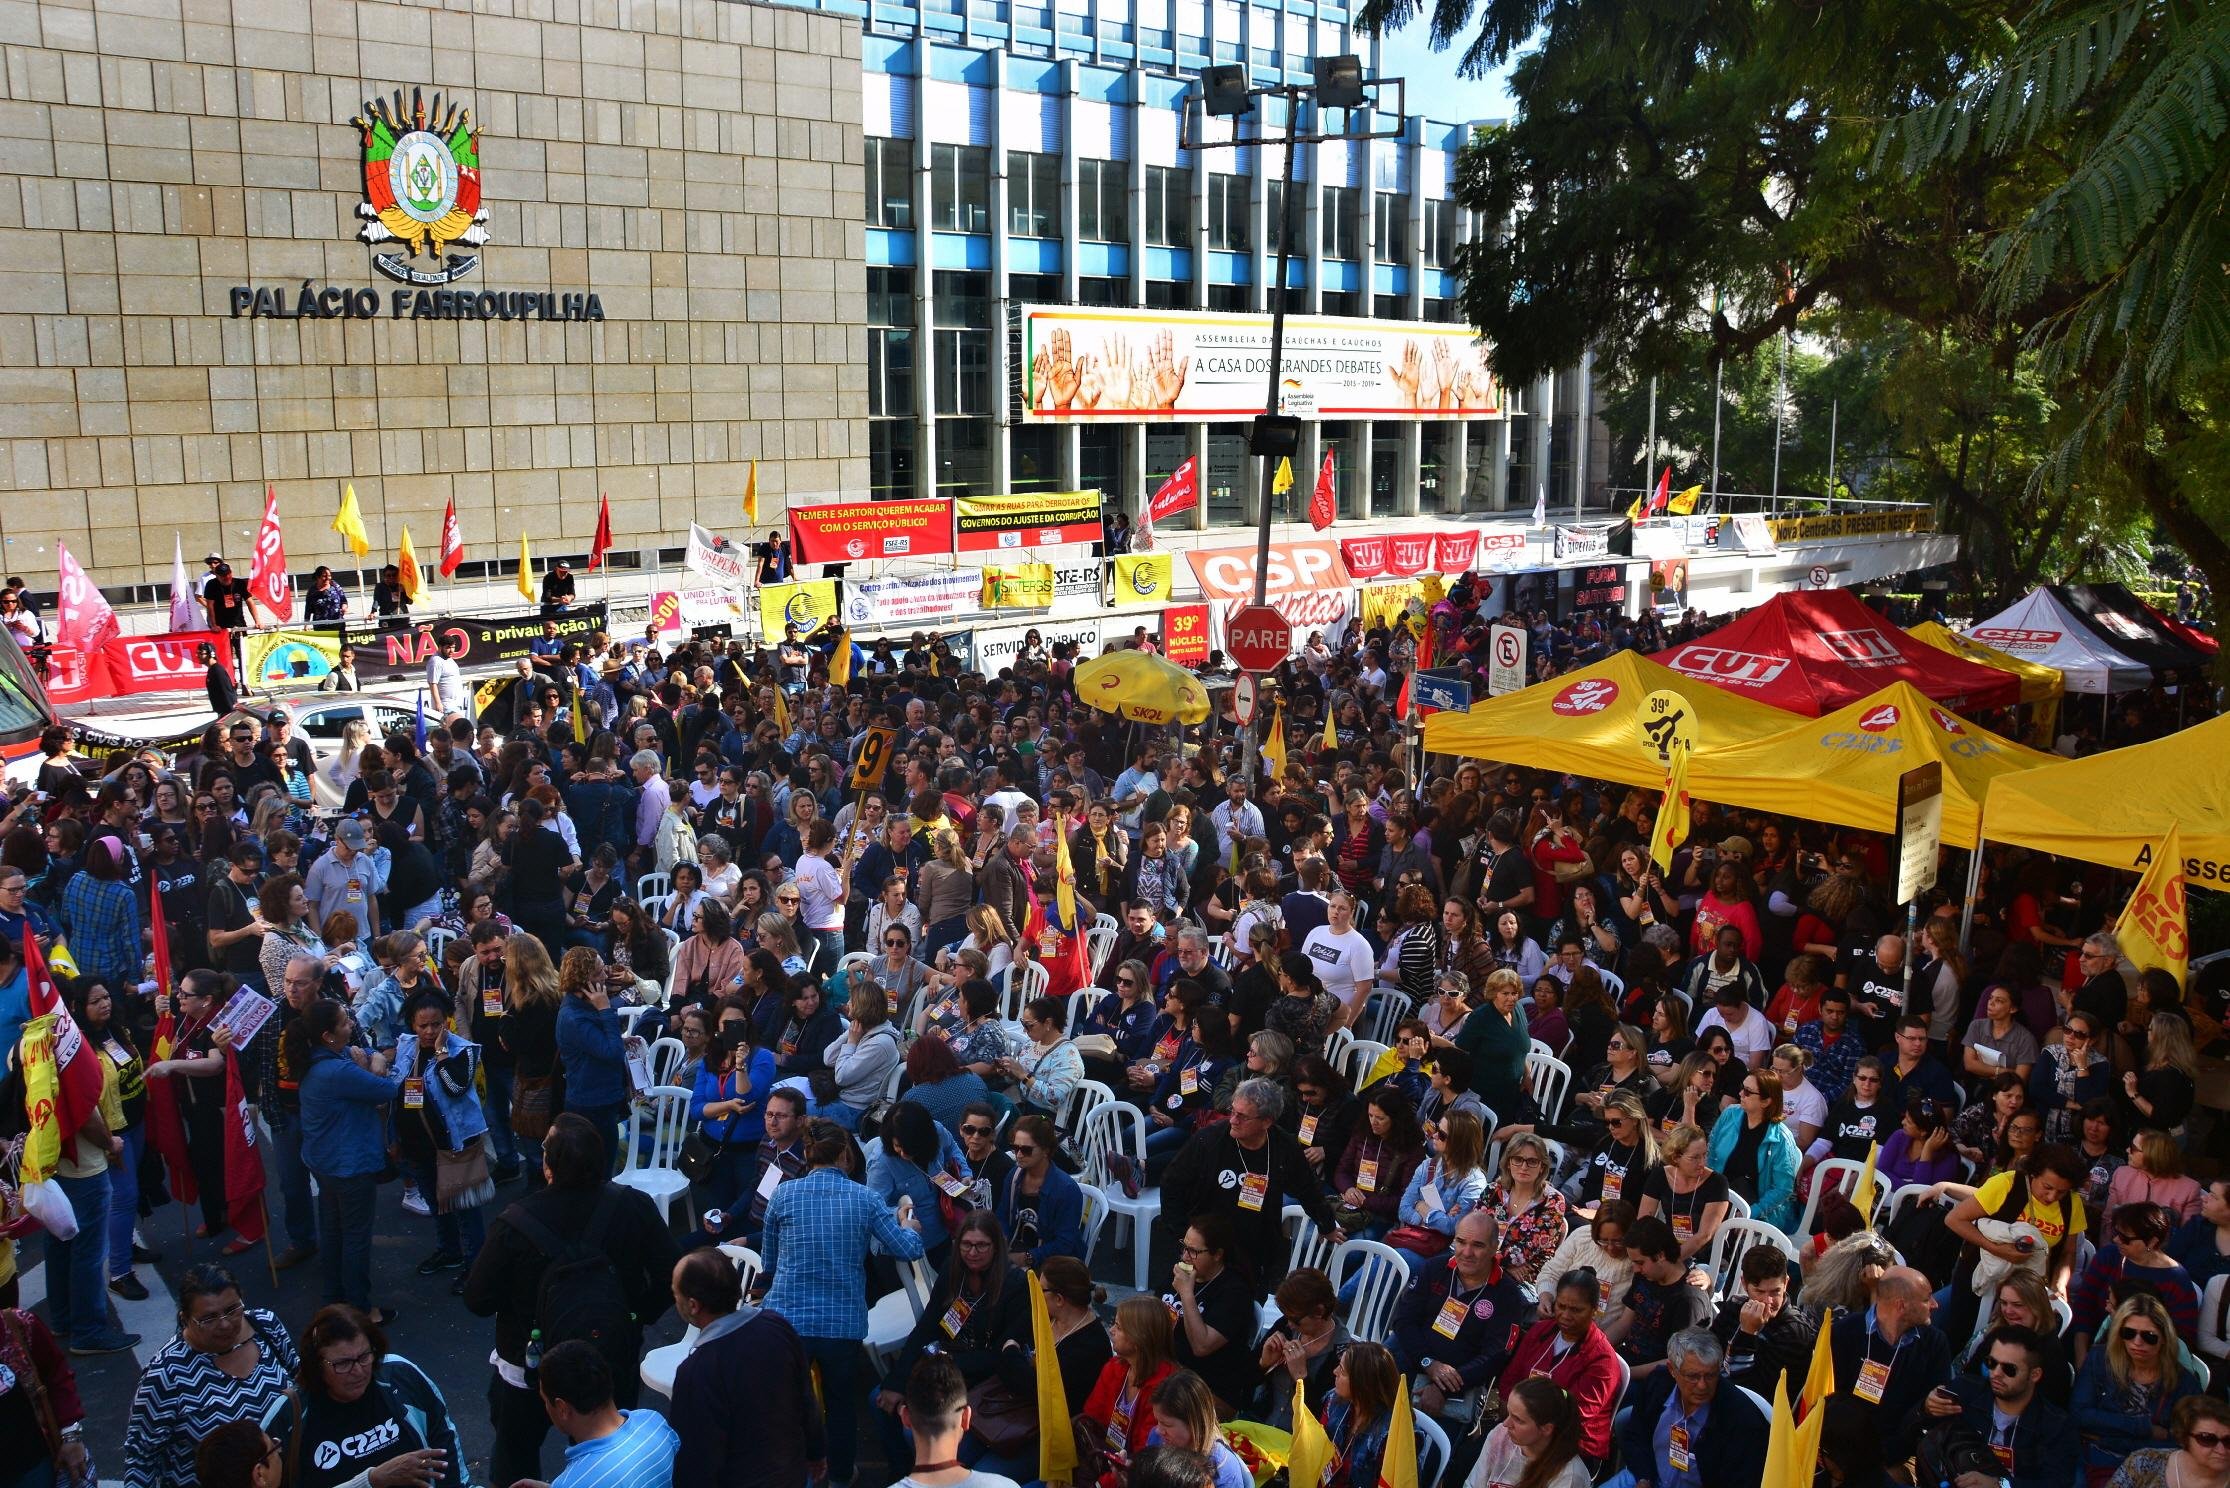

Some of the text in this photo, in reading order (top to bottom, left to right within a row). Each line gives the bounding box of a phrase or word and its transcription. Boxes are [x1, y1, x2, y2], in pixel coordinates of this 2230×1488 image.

[412, 272, 447, 282] IGUALDADE
[231, 279, 605, 321] PALÁCIO FARROUPILHA
[1195, 334, 1256, 343] ASSEMBLEIA
[1195, 358, 1382, 374] A CASA DOS GRANDES DEBATES
[797, 503, 946, 520] TEMER E SARTORI QUEREM ACABAR
[1006, 502, 1026, 510] RUAS
[1026, 500, 1044, 509] PARA
[1045, 498, 1080, 507] DERROTAR
[820, 517, 928, 532] COM O SERVIÇO PÚBLICO!
[961, 517, 1001, 528] GOVERNOS
[1001, 517, 1013, 525] DO
[1012, 515, 1039, 525] AJUSTE
[1044, 514, 1055, 522] DA
[1055, 509, 1099, 521] CORRUPÇÃO!
[1776, 525, 1797, 541] Nova
[1800, 519, 1842, 538] Central-RS
[1846, 513, 1887, 533] PRESENTE
[1888, 511, 1912, 530] NESTE
[1486, 536, 1524, 549] CSP
[1353, 543, 1385, 567] CUT
[1396, 542, 1425, 566] CUT
[1443, 540, 1472, 564] CUT
[1204, 548, 1332, 594] CSP
[1586, 566, 1617, 584] FORA
[860, 582, 881, 592] Contra
[930, 576, 941, 585] dos
[1001, 578, 1052, 594] SINTERGS
[709, 596, 737, 606] LUTAR!
[1576, 586, 1625, 606] SARTORI
[652, 595, 679, 627] SOU
[481, 630, 492, 642] a
[495, 619, 588, 644] privatiação
[1173, 615, 1199, 632] 39º
[347, 632, 376, 648] Diga
[1045, 630, 1097, 649] PÚBLICO
[1169, 636, 1204, 647] NÚCLEO
[1231, 628, 1288, 649] PARE
[1980, 630, 2055, 640] CSP
[386, 624, 471, 666] NÃO
[500, 651, 511, 659] EM
[1677, 648, 1785, 680] CUT
[1685, 672, 1725, 684] Grande
[1727, 678, 1741, 686] do
[1744, 681, 1766, 689] Sul
[1132, 706, 1163, 721] SKOL
[1651, 697, 1670, 714] 39º
[85, 730, 144, 748] CIVIS DO
[858, 731, 884, 778] 9
